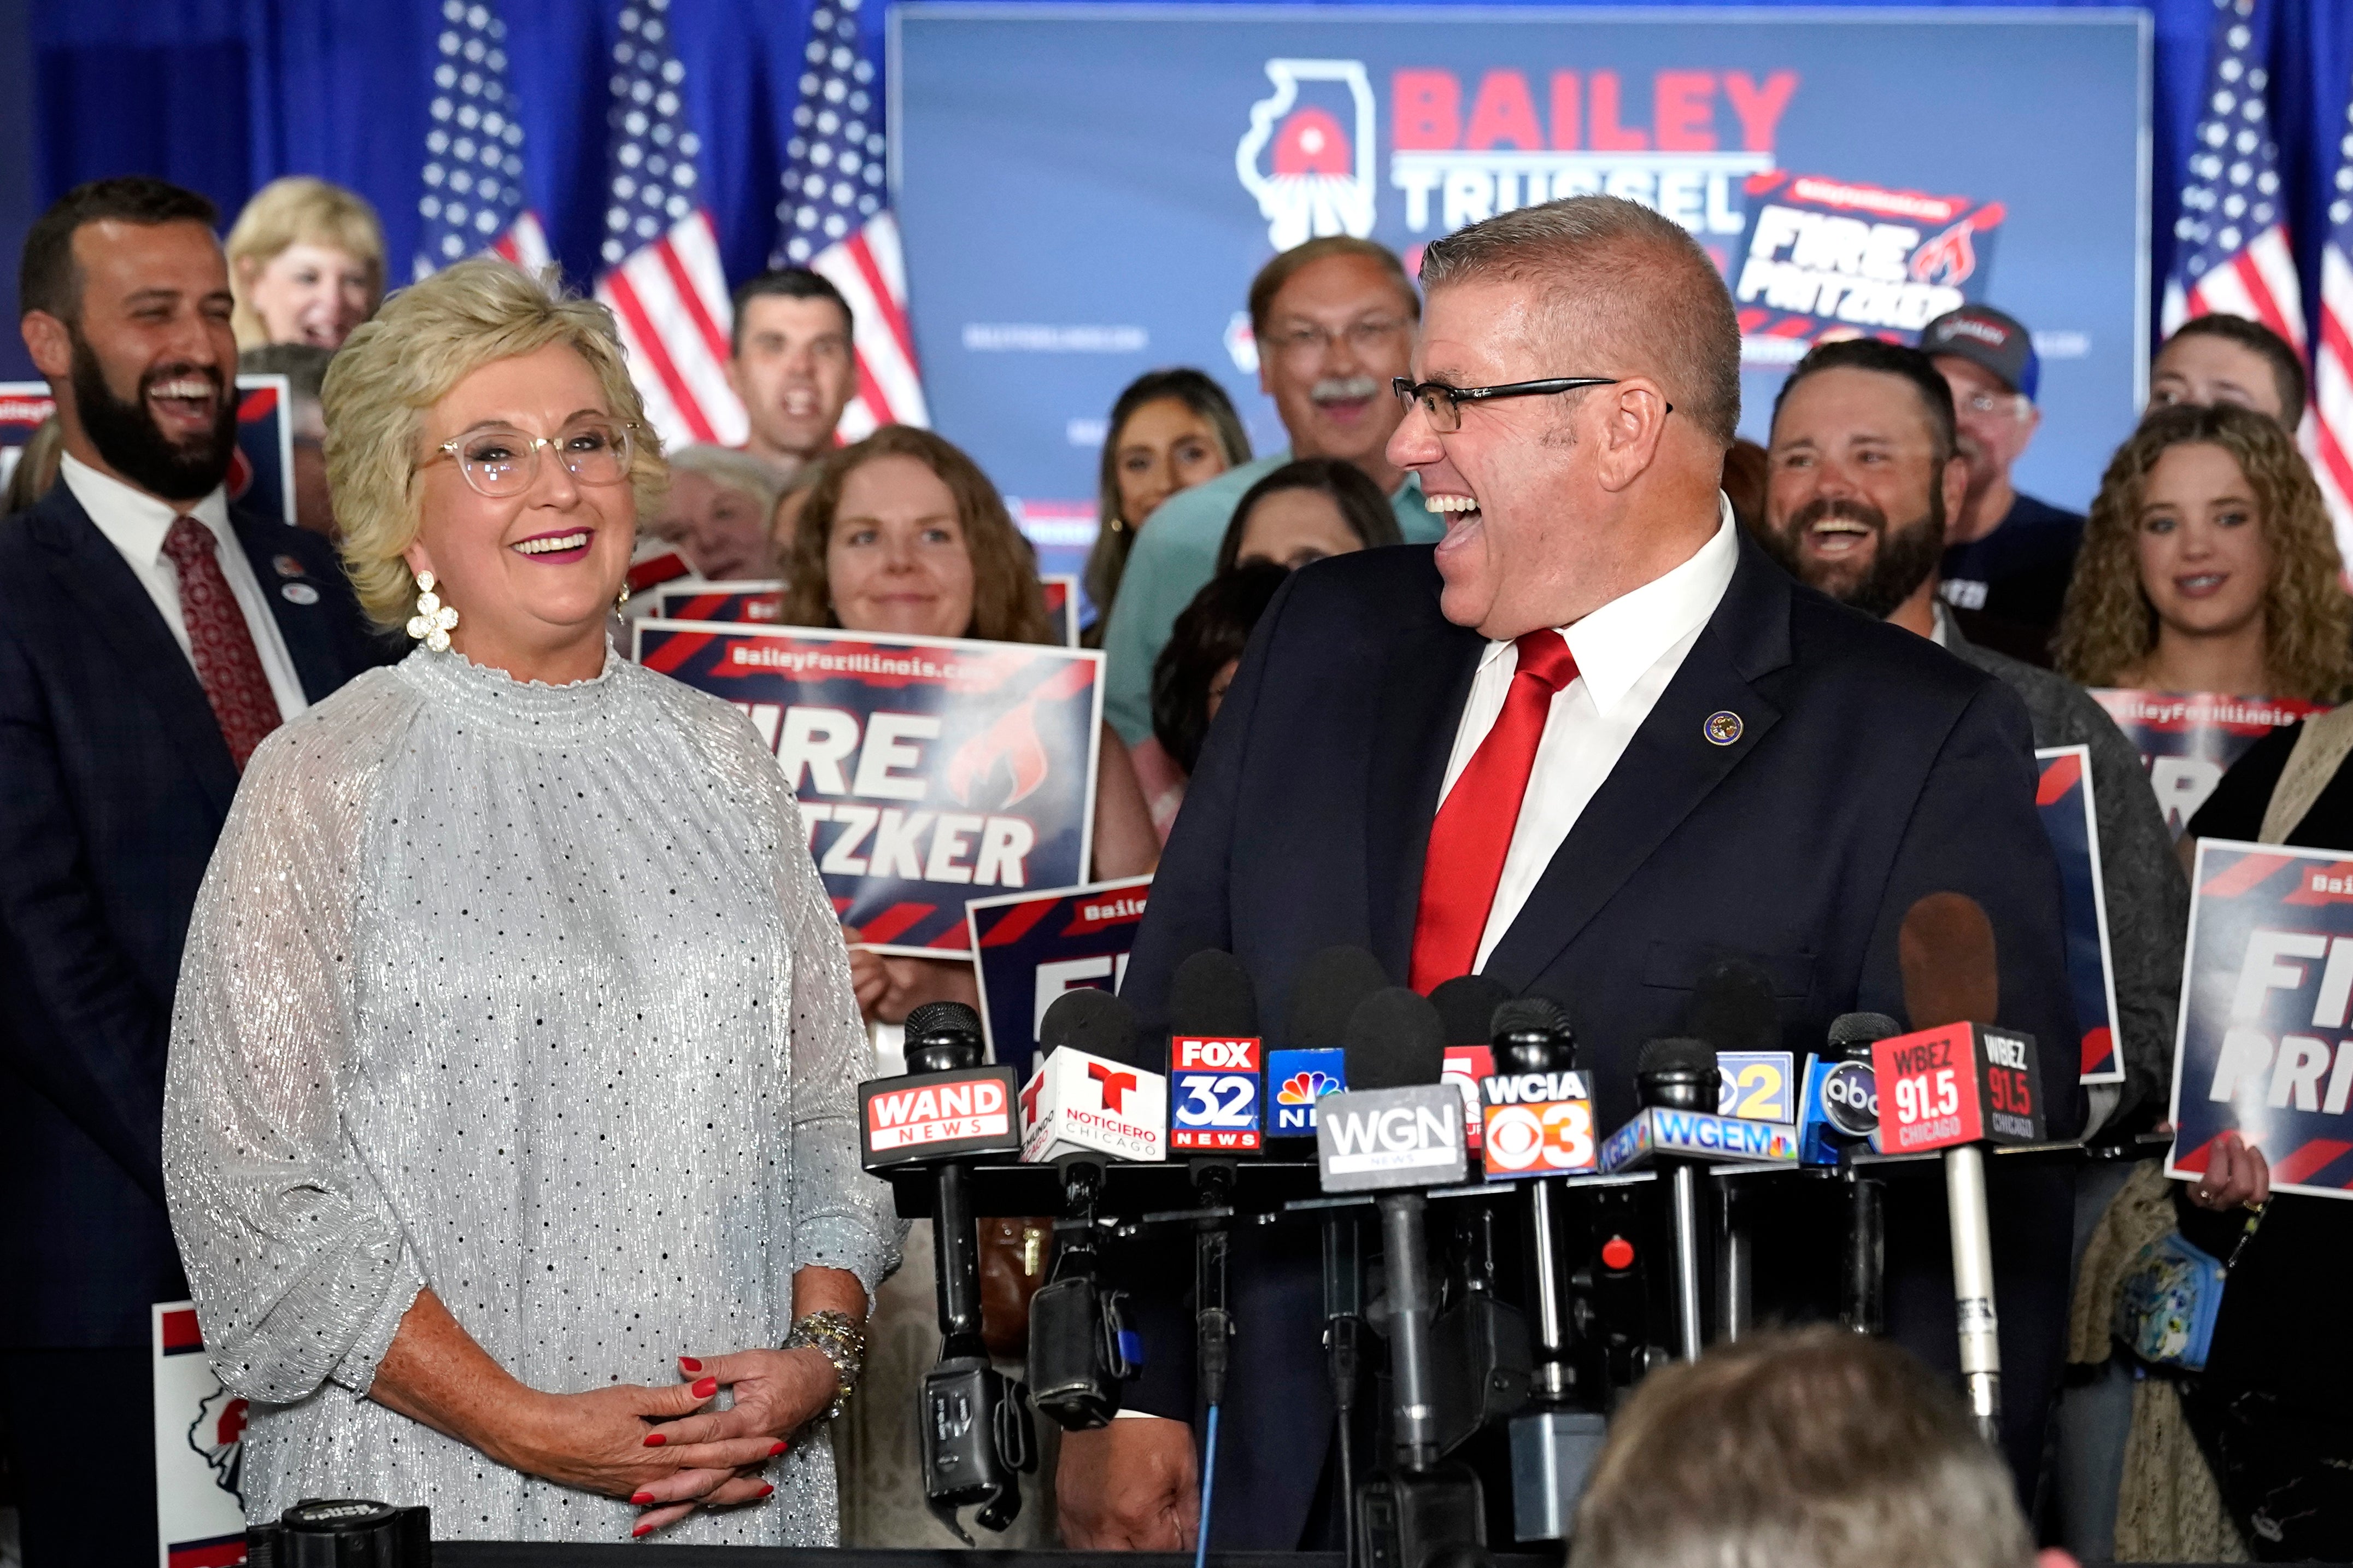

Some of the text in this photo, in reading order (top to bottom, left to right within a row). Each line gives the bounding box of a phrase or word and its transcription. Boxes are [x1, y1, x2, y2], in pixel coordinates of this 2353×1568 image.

[1392, 69, 1799, 152] BAILEY
[799, 803, 1035, 888] TZKER
[1182, 1041, 1252, 1068] FOX
[1893, 1040, 1953, 1076] WBEZ
[1985, 1034, 2028, 1071] WBEZ
[875, 1083, 1002, 1127] WAND
[1176, 1076, 1255, 1126] 32
[1484, 1073, 1587, 1105] WCIA
[1736, 1064, 1782, 1119] 2
[1895, 1070, 1958, 1124] 91.5
[899, 1119, 981, 1143] NEWS
[1066, 1123, 1156, 1156] CHICAGO
[1067, 1108, 1156, 1143] NOTICIERO
[1177, 1133, 1255, 1146] NEWS
[1326, 1104, 1455, 1156] WGN
[1541, 1104, 1594, 1168] 3
[1655, 1111, 1771, 1155] WGEM
[1899, 1118, 1961, 1147] CHICAGO
[1371, 1154, 1415, 1166] NEWS
